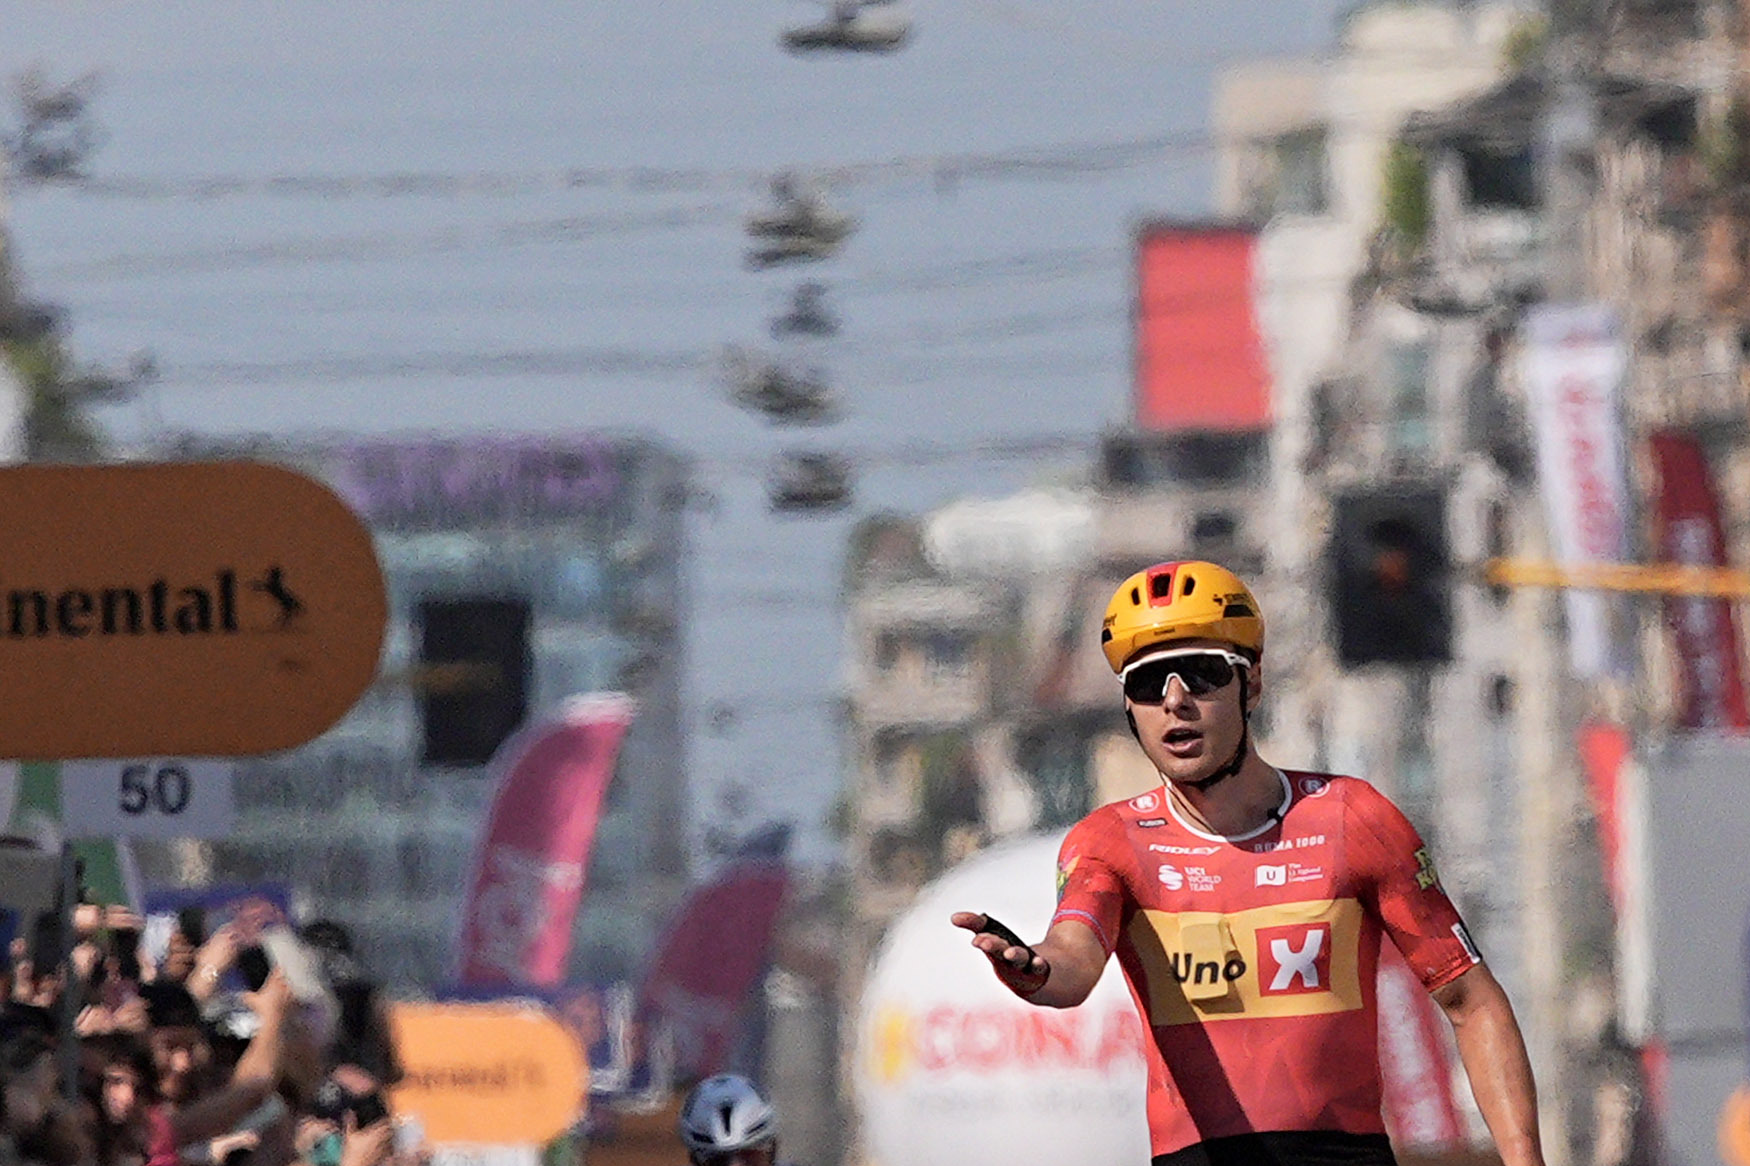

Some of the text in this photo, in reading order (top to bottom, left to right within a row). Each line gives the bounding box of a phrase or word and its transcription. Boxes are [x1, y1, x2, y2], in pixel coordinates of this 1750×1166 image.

[0, 568, 239, 639] nental
[119, 764, 192, 816] 50
[1149, 843, 1221, 856] RIDLEY
[1170, 929, 1324, 991] Uno X
